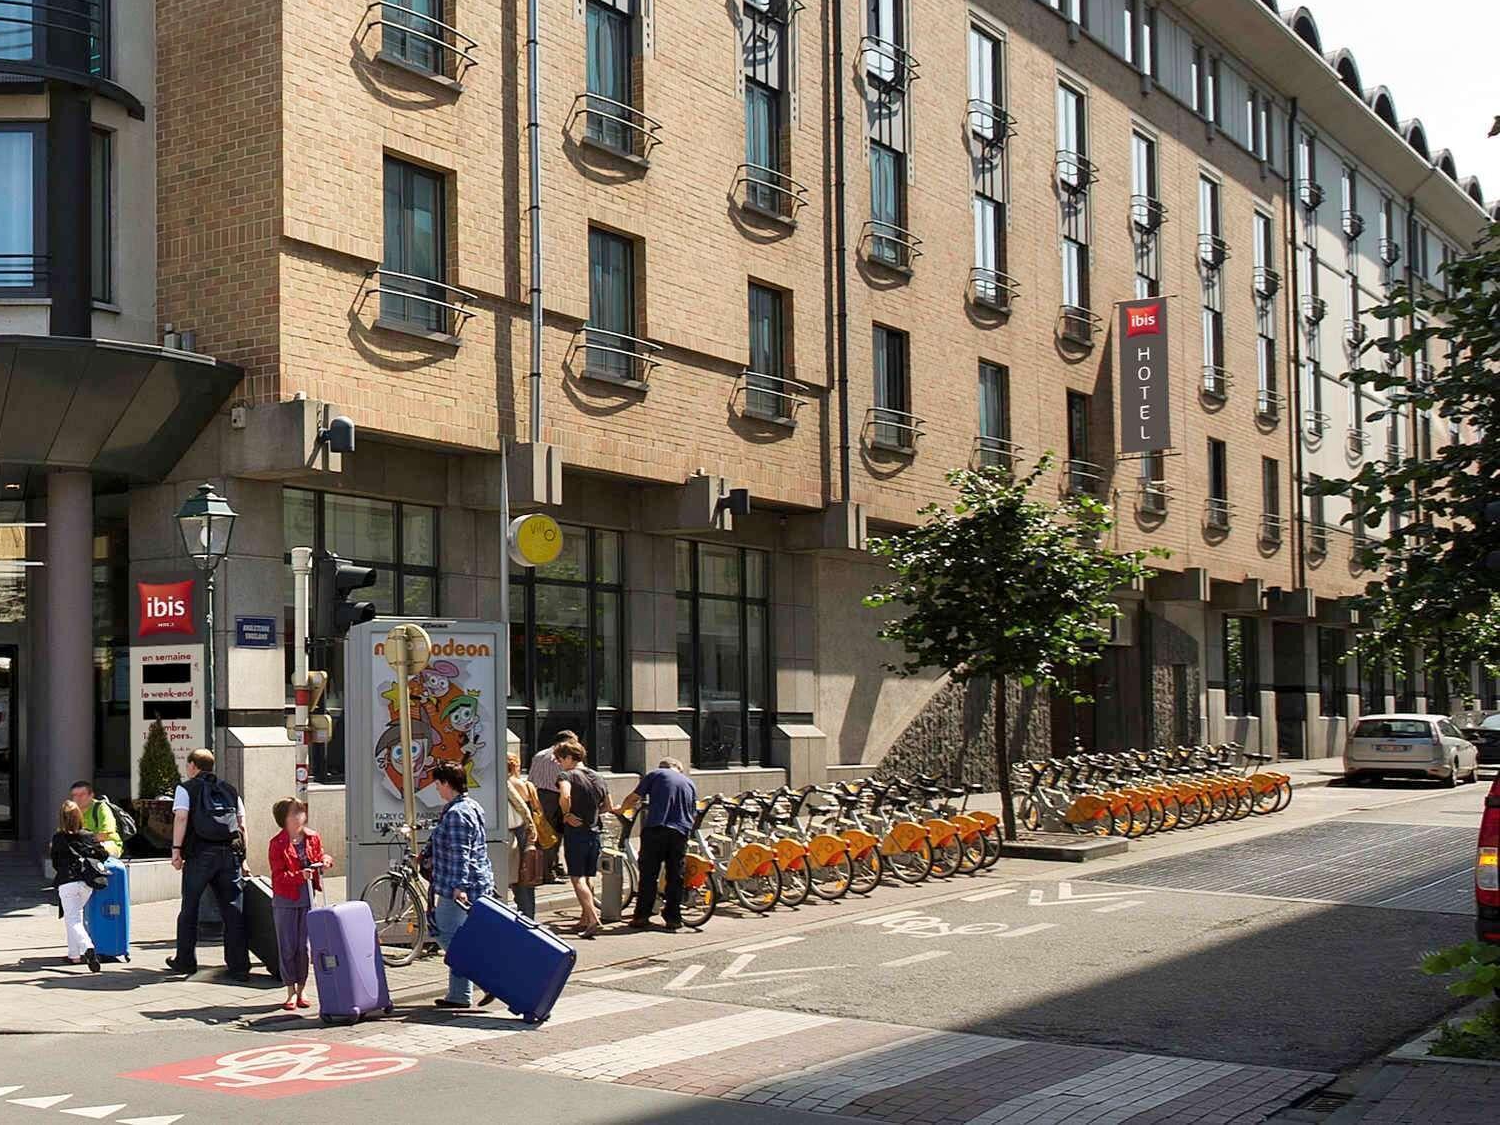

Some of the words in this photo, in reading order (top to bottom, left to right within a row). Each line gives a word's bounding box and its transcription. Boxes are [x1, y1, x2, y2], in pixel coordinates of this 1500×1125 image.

[1131, 313, 1156, 328] ibis
[1137, 346, 1151, 440] HOTEL
[147, 595, 186, 618] ibis
[374, 637, 490, 657] nodeon
[155, 652, 192, 661] semaine
[141, 688, 149, 699] le
[150, 686, 194, 699] week-end
[170, 733, 193, 742] pers.
